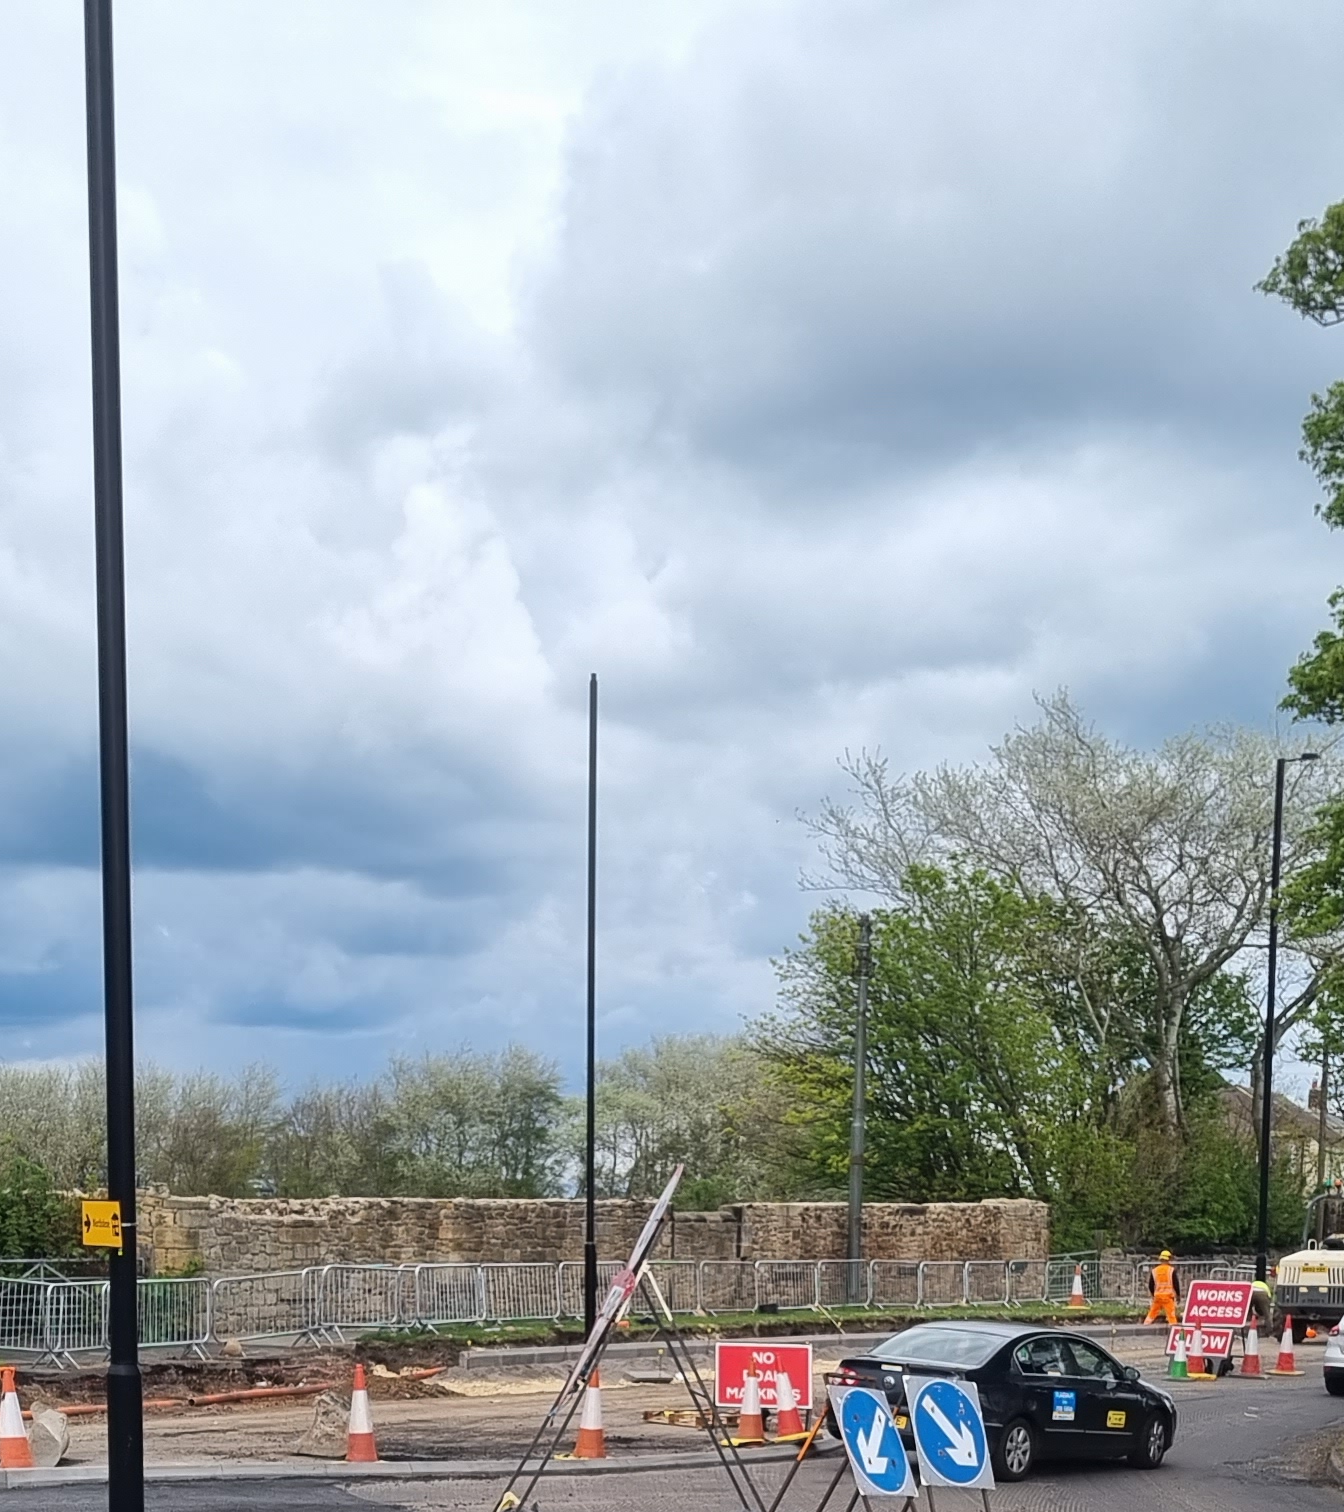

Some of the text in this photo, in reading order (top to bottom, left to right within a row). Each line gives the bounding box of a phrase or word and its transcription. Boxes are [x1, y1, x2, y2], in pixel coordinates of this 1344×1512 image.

[1197, 1289, 1243, 1302] WORKS
[1190, 1305, 1243, 1318] ACCESS
[752, 1351, 775, 1364] NO
[743, 1369, 784, 1382] OA
[726, 1386, 801, 1401] MAKINS
